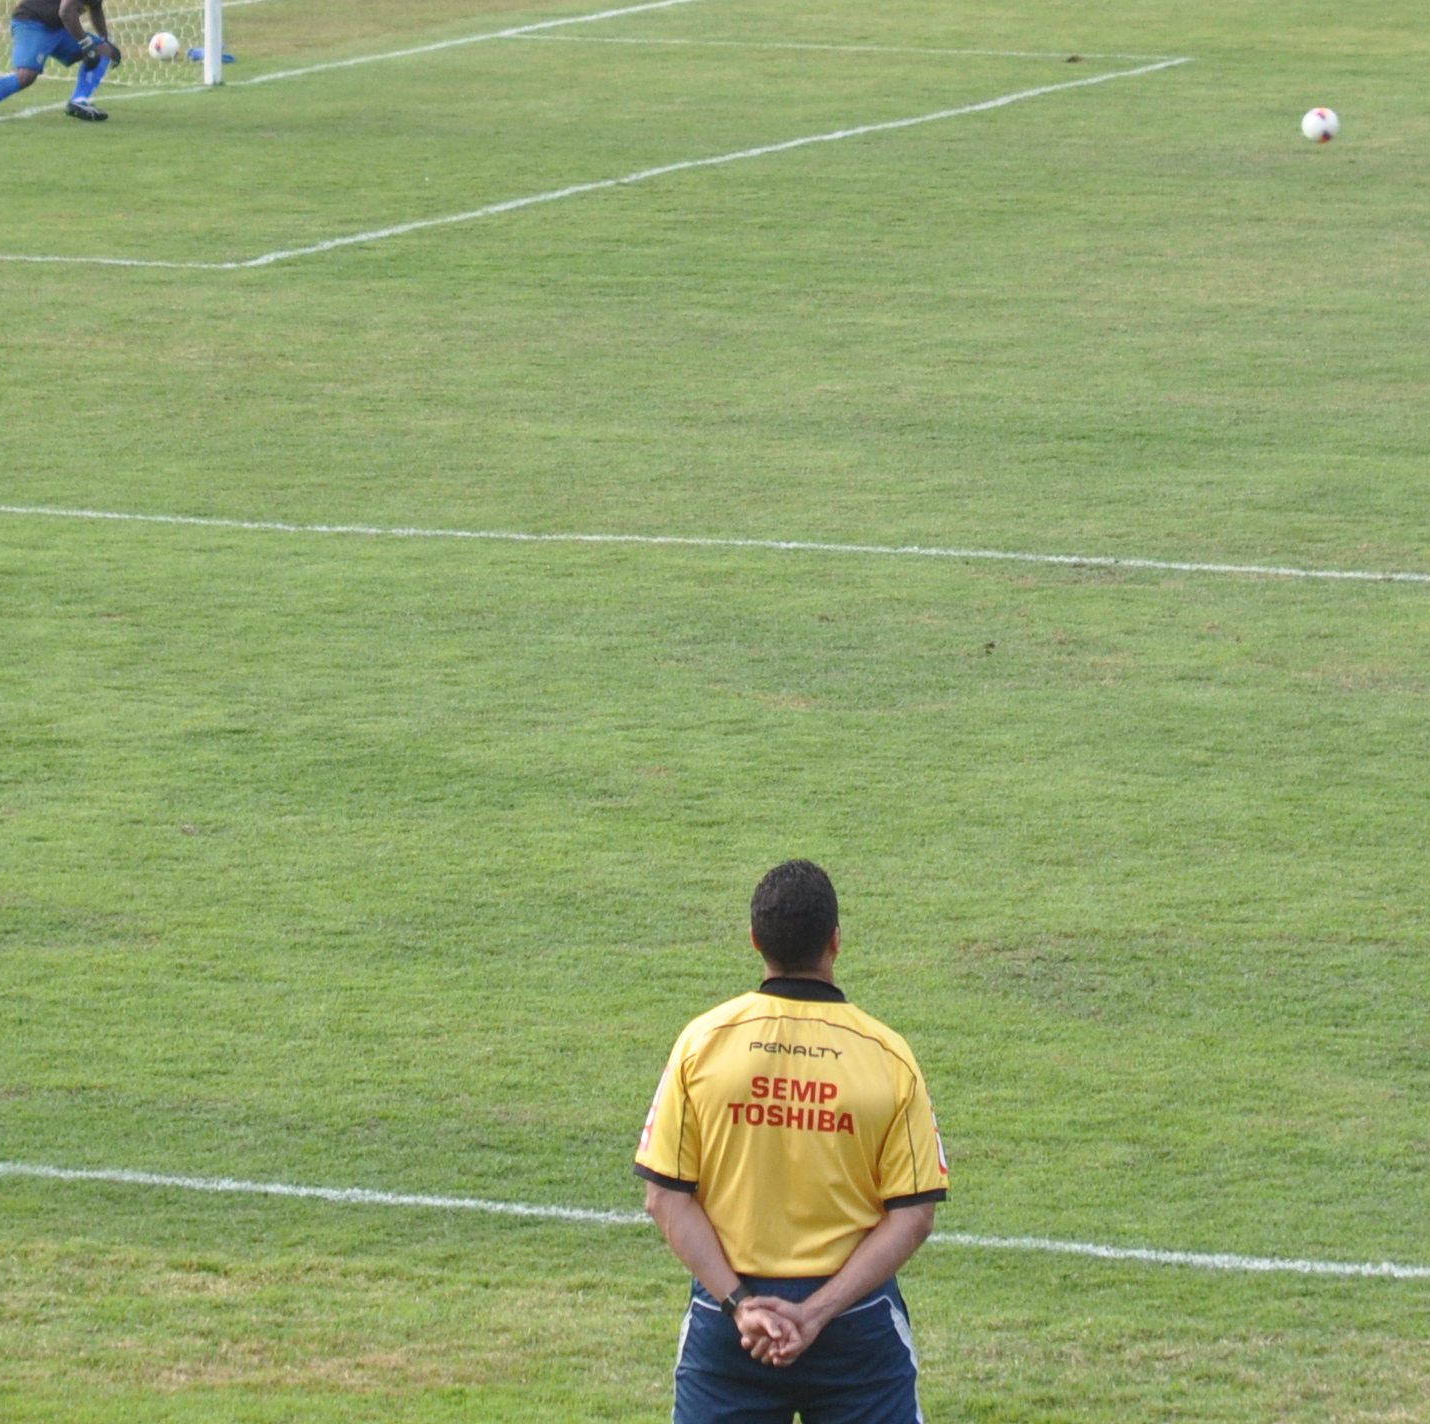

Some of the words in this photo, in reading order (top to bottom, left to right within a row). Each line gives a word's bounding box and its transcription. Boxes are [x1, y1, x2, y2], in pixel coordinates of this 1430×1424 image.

[749, 1041, 842, 1060] PENALTY
[751, 1076, 838, 1104] SEMP
[727, 1102, 855, 1135] TOSHIBA
